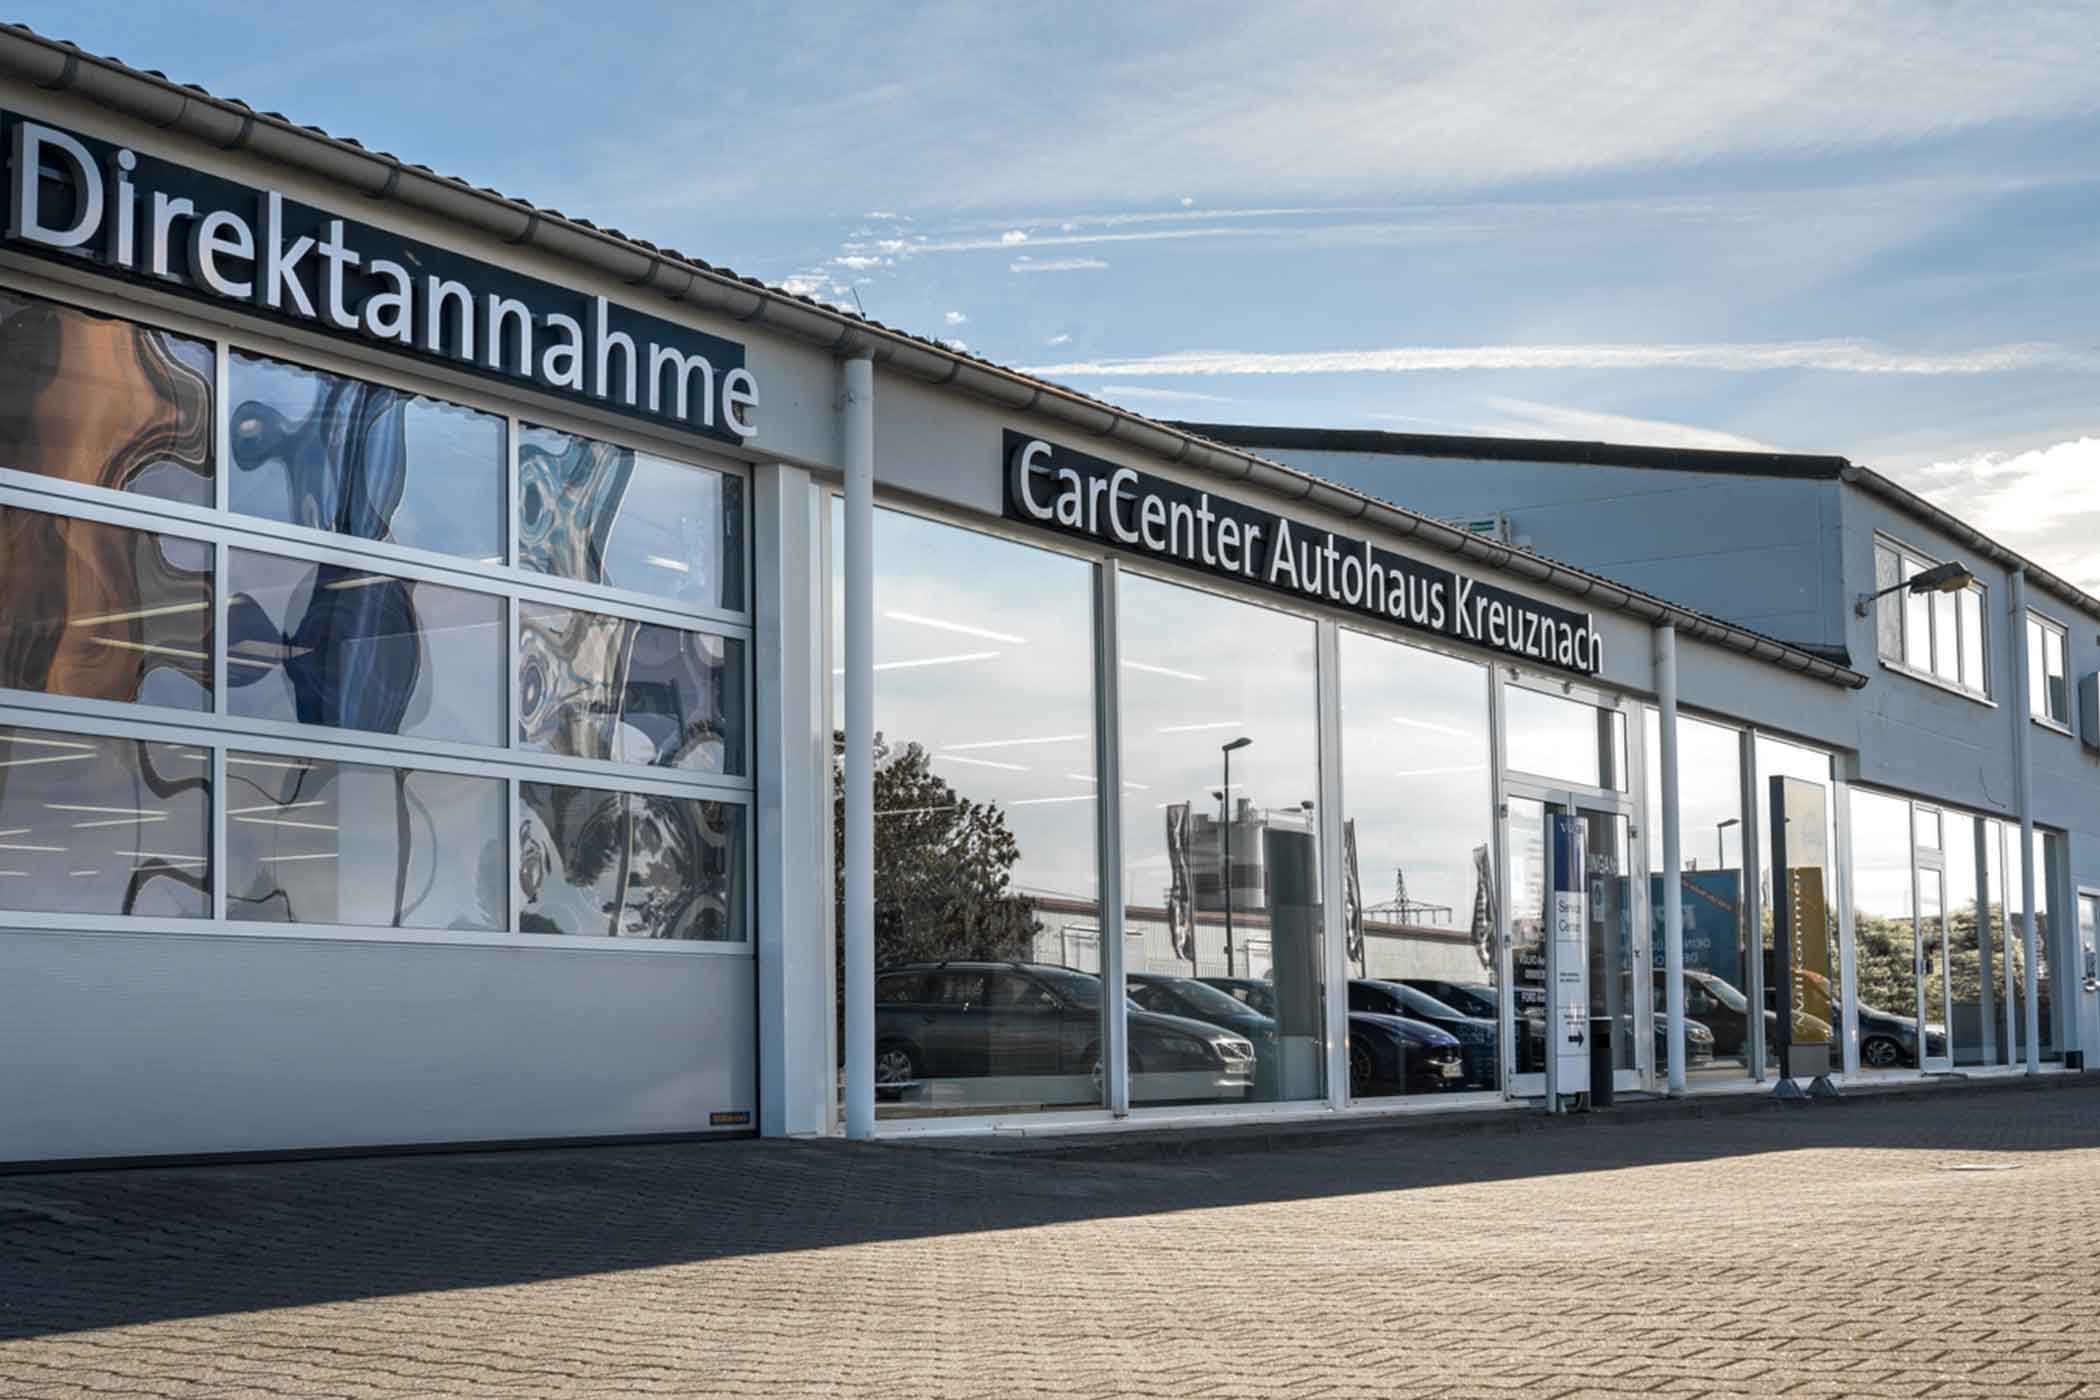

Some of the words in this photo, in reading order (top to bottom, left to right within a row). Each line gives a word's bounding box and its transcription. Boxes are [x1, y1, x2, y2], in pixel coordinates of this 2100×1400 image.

[12, 120, 760, 438] Direktannahme
[1018, 440, 1261, 577] CarCenter
[1270, 518, 1445, 630] Autohaus
[1454, 575, 1604, 674] Kreuznach
